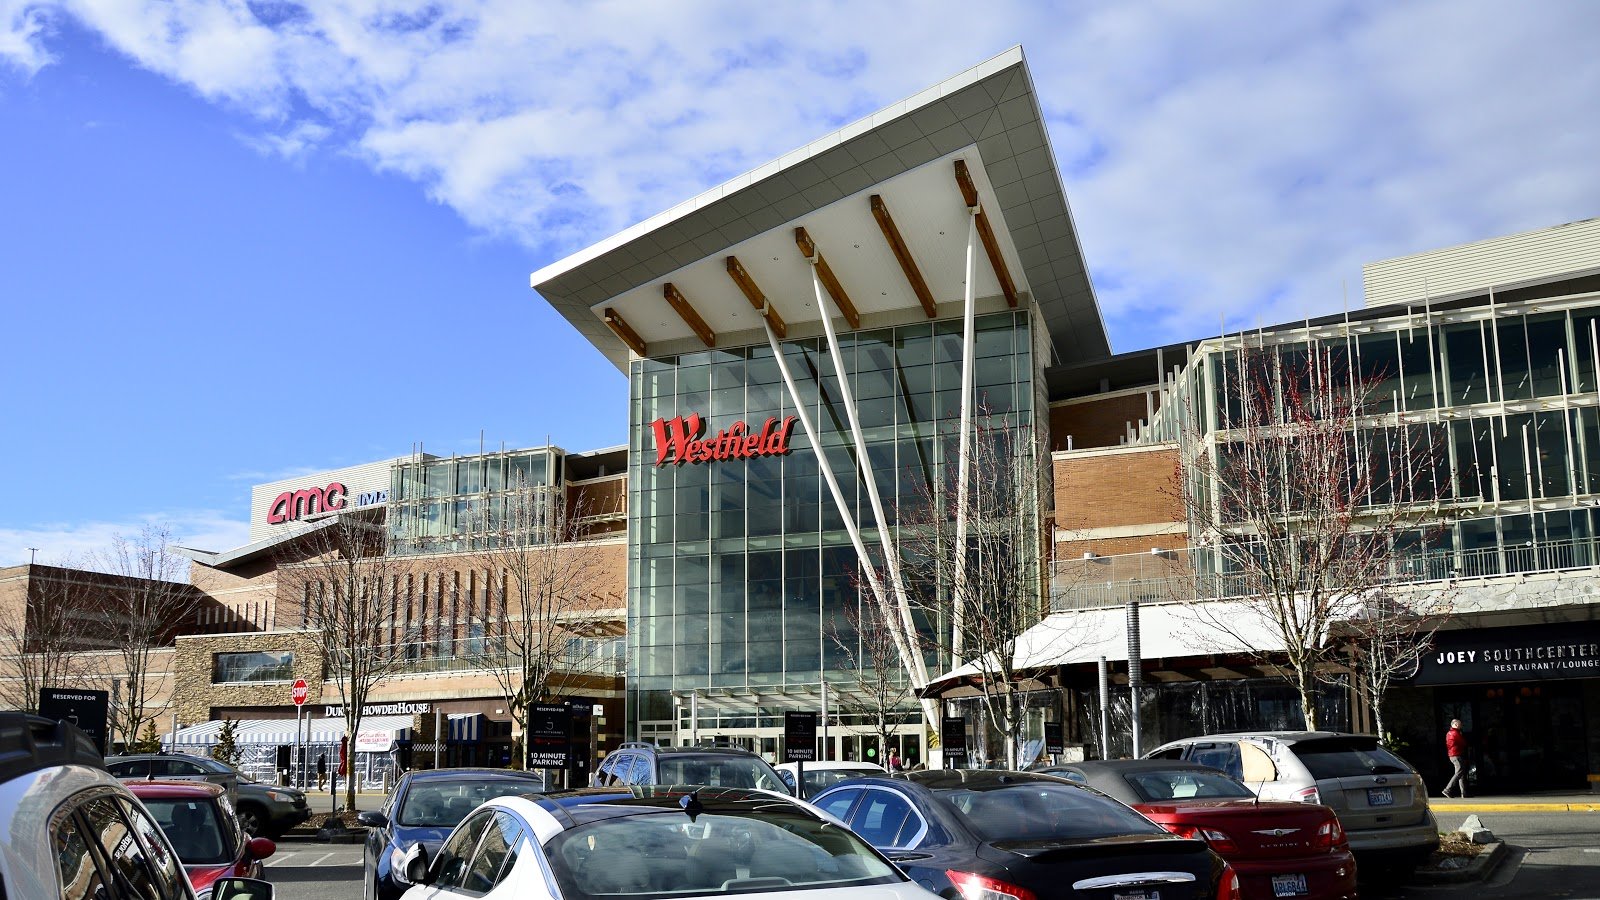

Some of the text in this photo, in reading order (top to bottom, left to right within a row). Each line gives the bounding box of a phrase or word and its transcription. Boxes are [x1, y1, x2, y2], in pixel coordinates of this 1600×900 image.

[648, 412, 797, 467] Westfield
[357, 490, 388, 507] IMA
[1437, 643, 1599, 664] JOEY SOUTHCENTER
[1494, 659, 1599, 672] RESTAURANT/LOUNGE
[293, 687, 307, 698] STOP
[362, 702, 429, 716] HOWDERHOUSE
